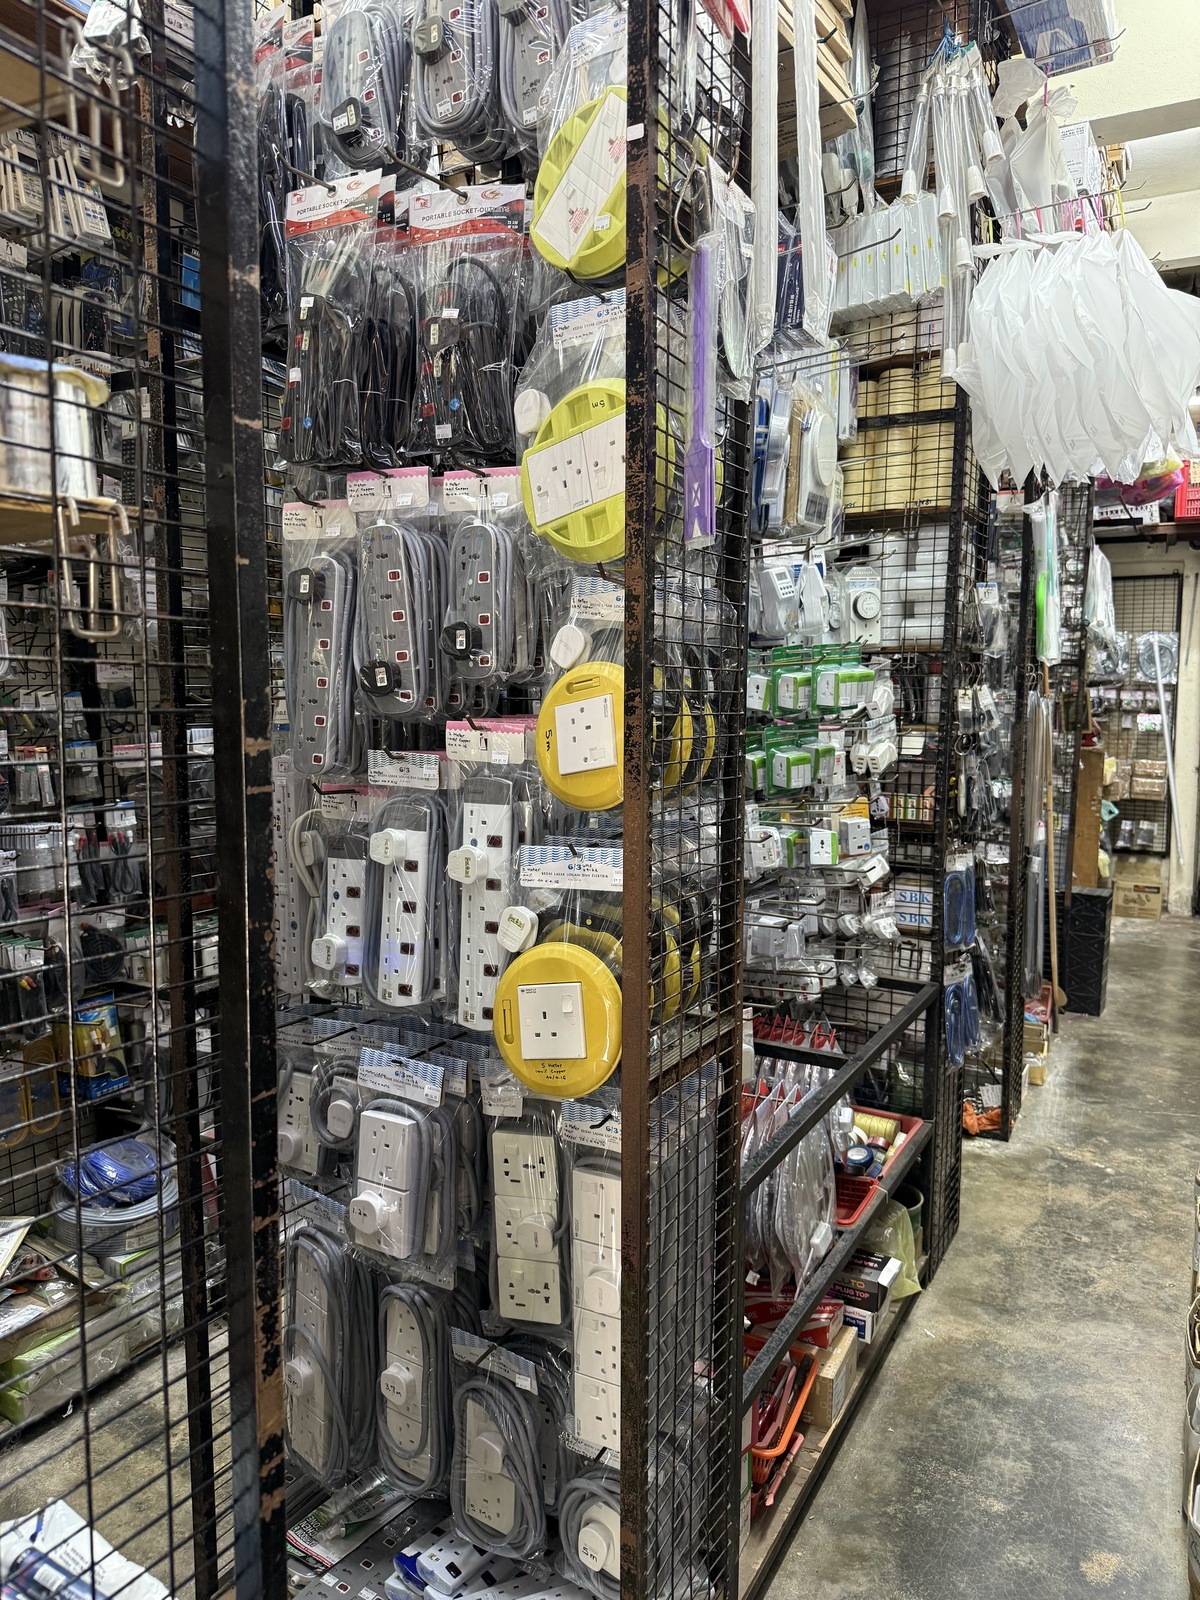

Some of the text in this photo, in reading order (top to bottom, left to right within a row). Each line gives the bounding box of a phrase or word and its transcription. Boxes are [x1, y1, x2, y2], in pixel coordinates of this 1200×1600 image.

[296, 206, 321, 216] PORTABLE
[422, 211, 452, 222] PORTABLE
[596, 308, 610, 318] 6/3
[592, 400, 605, 408] 5m
[545, 729, 553, 752] 5m
[898, 892, 930, 904] SBK
[898, 913, 930, 925] SBK
[394, 1070, 405, 1079] 6/3
[606, 1126, 618, 1134] 6/3
[352, 1207, 368, 1218] 1.2m
[835, 1285, 870, 1298] PLUG TOP
[287, 1374, 299, 1389] 5m
[581, 1546, 598, 1562] 5m
